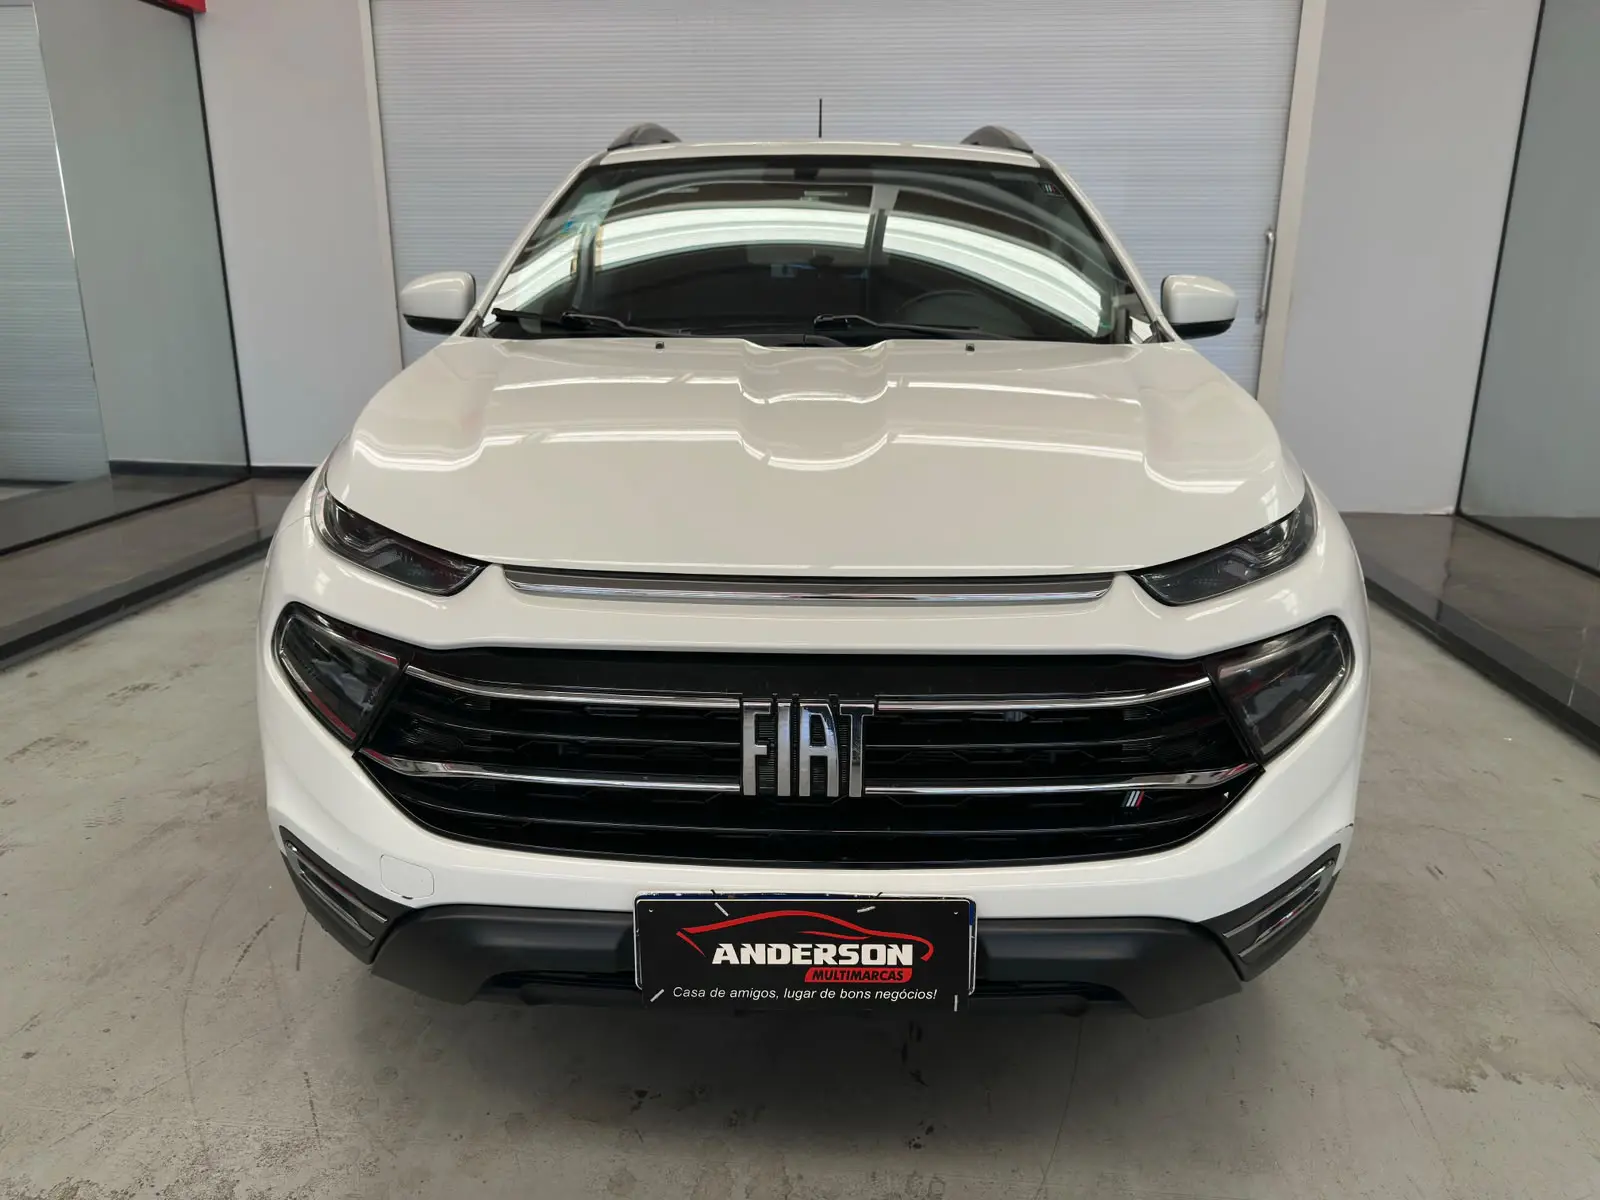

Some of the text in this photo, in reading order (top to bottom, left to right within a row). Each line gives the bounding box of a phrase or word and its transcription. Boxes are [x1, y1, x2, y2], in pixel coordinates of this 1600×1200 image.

[742, 701, 875, 797] FIAT
[712, 943, 912, 965] ANDERSON
[811, 968, 904, 981] MULTIMARCAS
[672, 986, 937, 1002] Casa de amigos, lugar de bons negócios!
